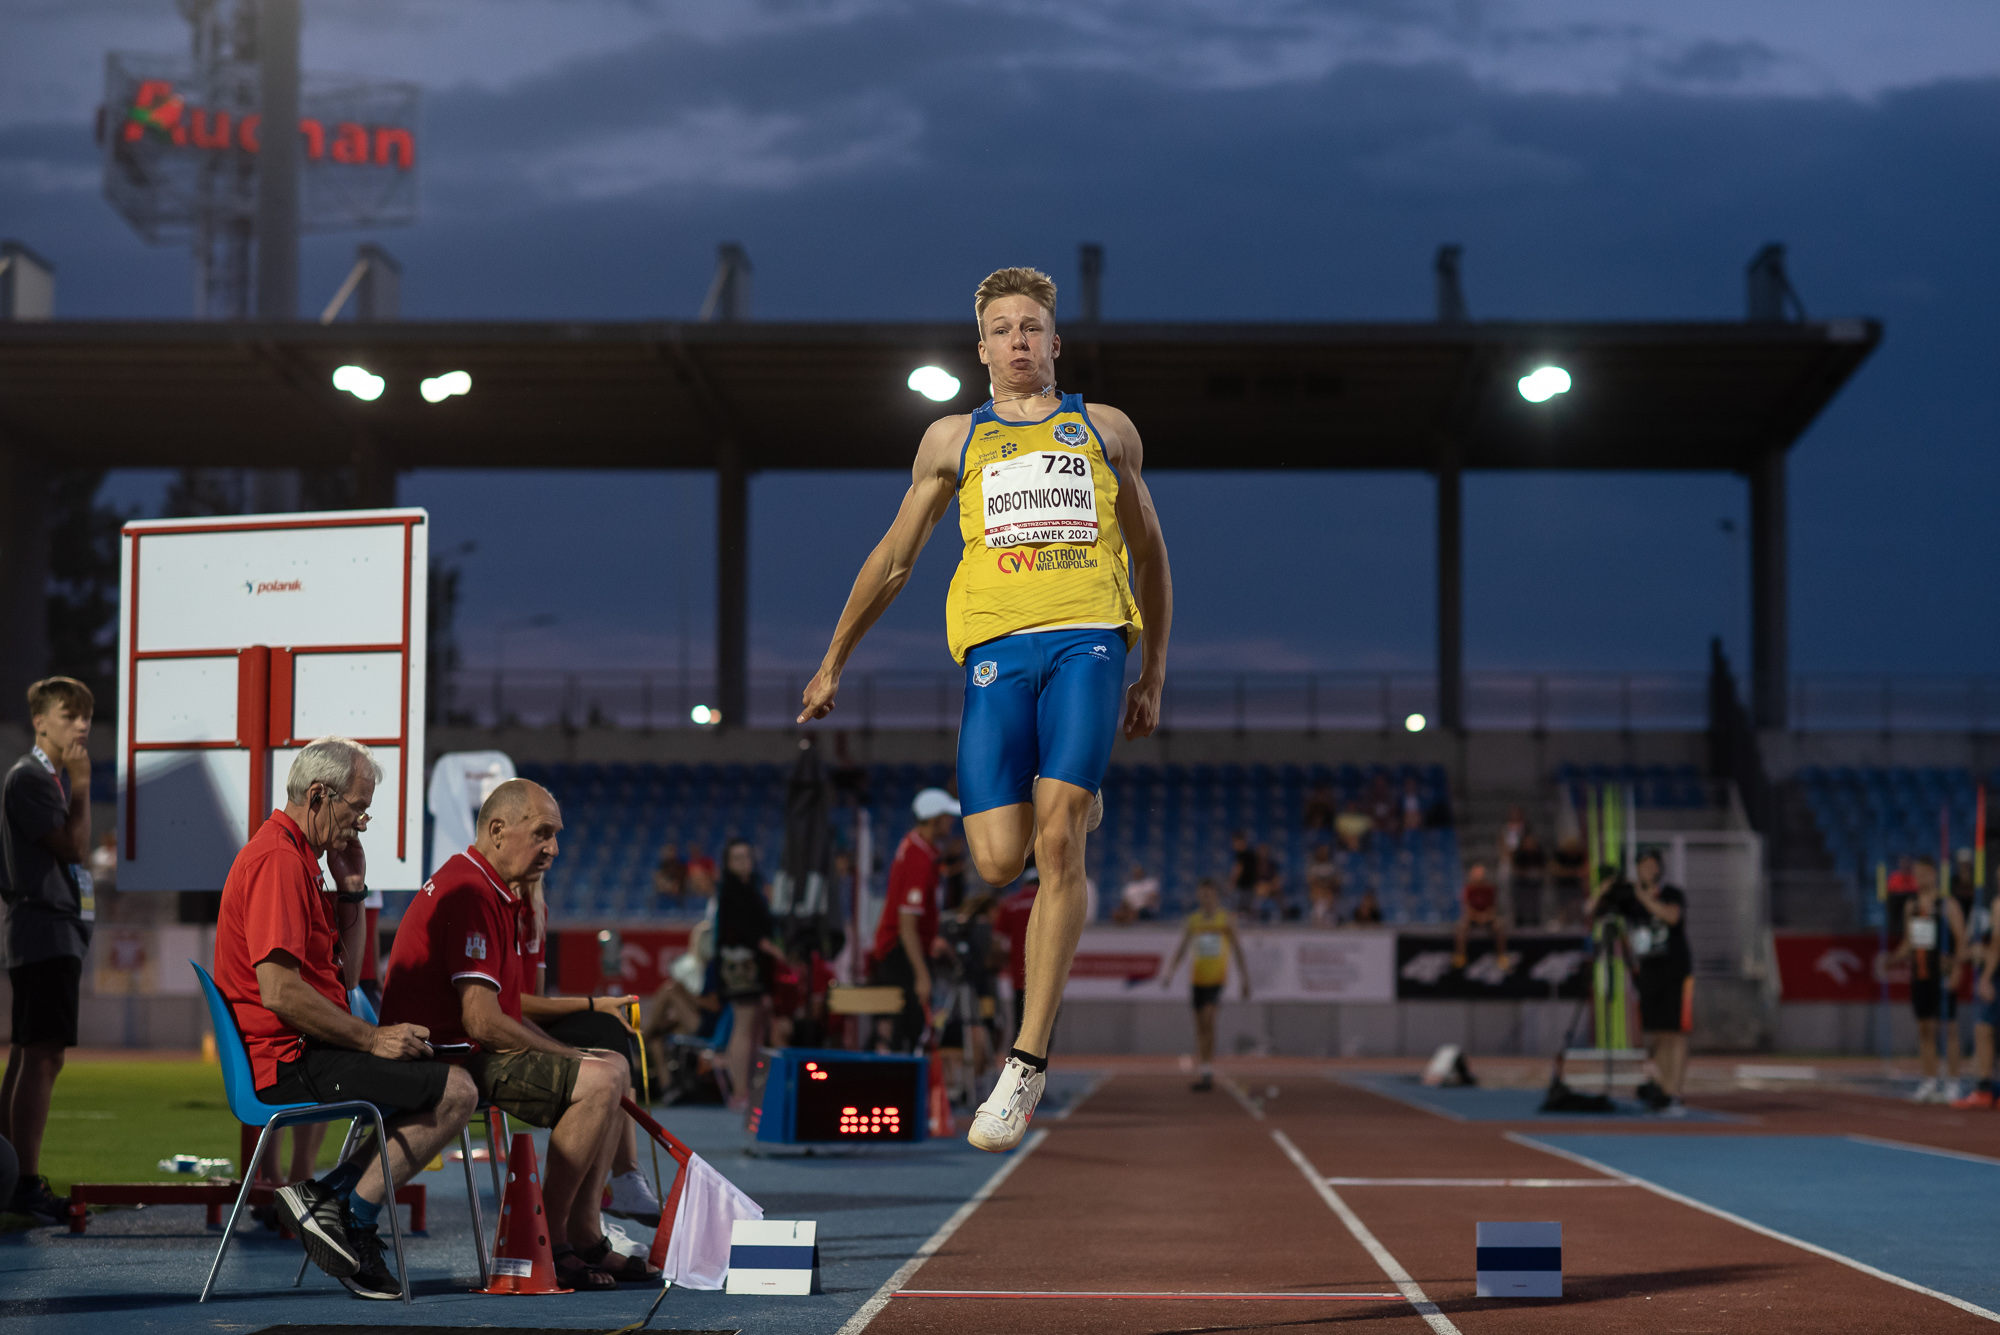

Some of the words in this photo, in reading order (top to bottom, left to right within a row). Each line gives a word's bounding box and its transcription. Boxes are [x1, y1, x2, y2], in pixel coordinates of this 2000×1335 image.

[1042, 454, 1086, 477] 728
[988, 487, 1092, 516] ROBOTNIKOWSKI
[991, 530, 1064, 546] WŁOCŁAWEK
[1068, 529, 1093, 540] 2021
[1038, 546, 1087, 563] OSTRÓW
[1035, 559, 1098, 572] WIELKOPOLSKI
[257, 579, 302, 596] polanik
